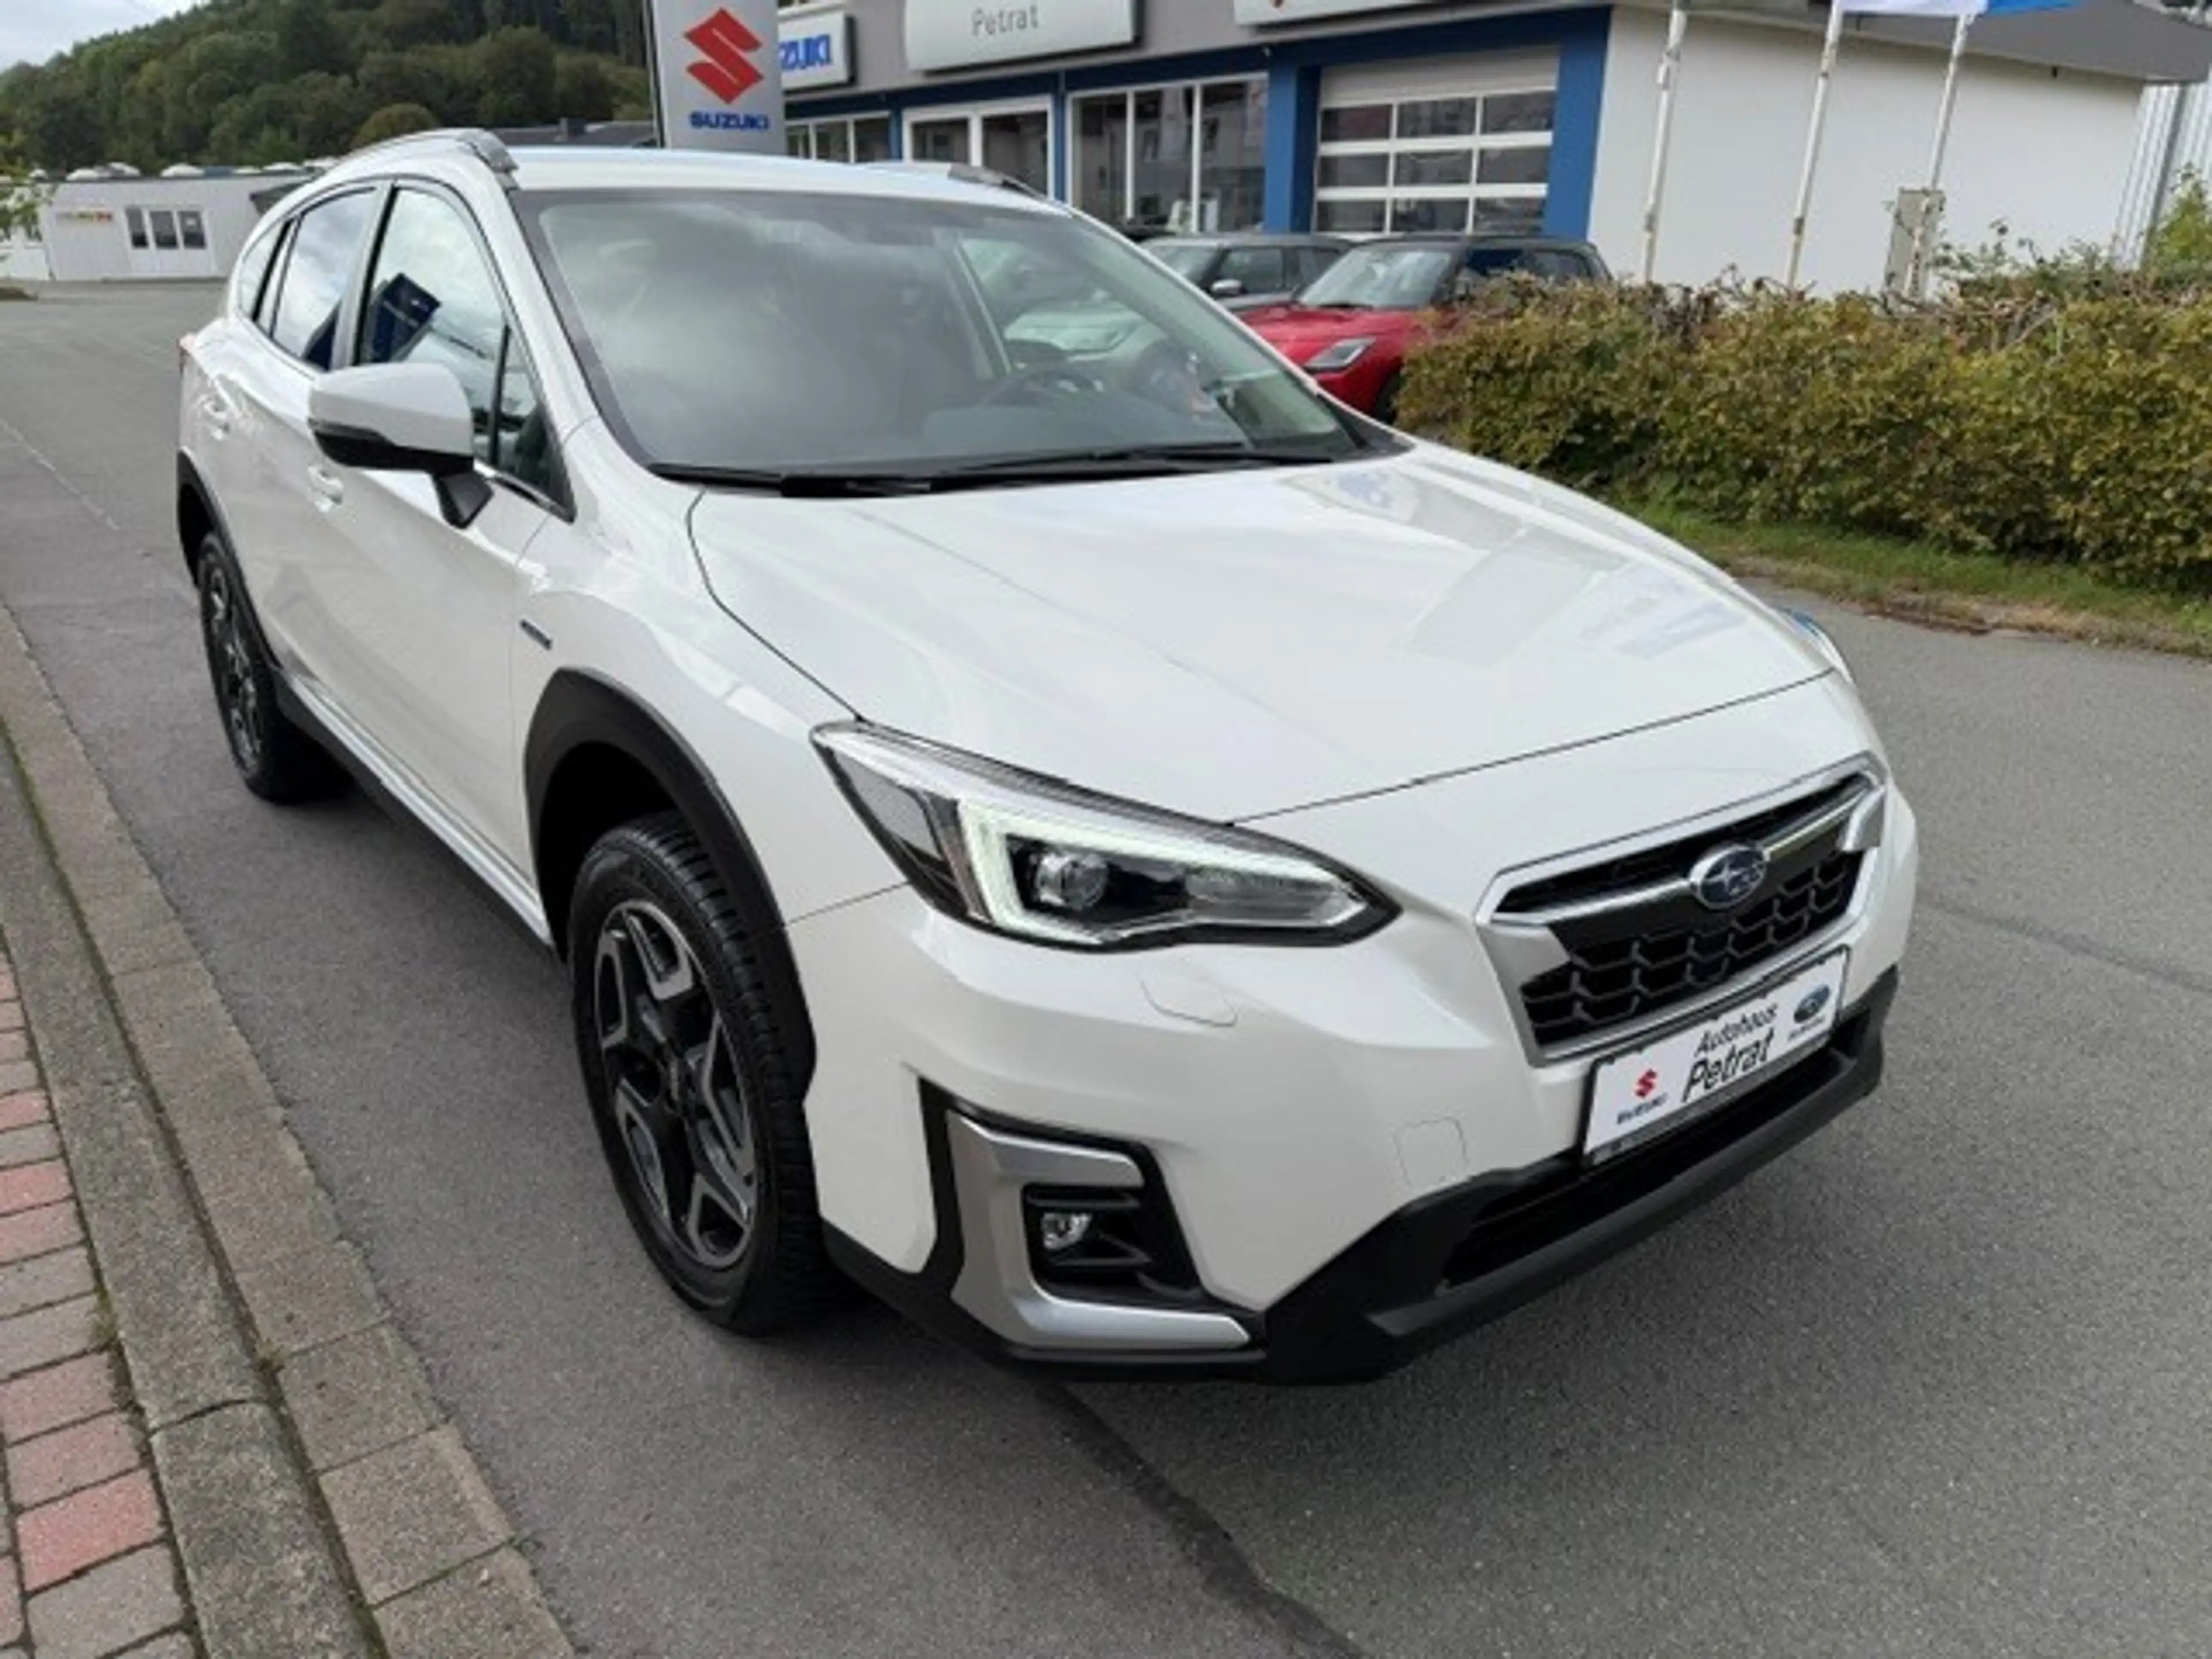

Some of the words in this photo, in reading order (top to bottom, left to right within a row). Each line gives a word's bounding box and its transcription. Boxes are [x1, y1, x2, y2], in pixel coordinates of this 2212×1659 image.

[971, 5, 1038, 36] Petrat
[690, 111, 770, 130] SUZUKI
[1681, 1028, 1775, 1103] Petrat
